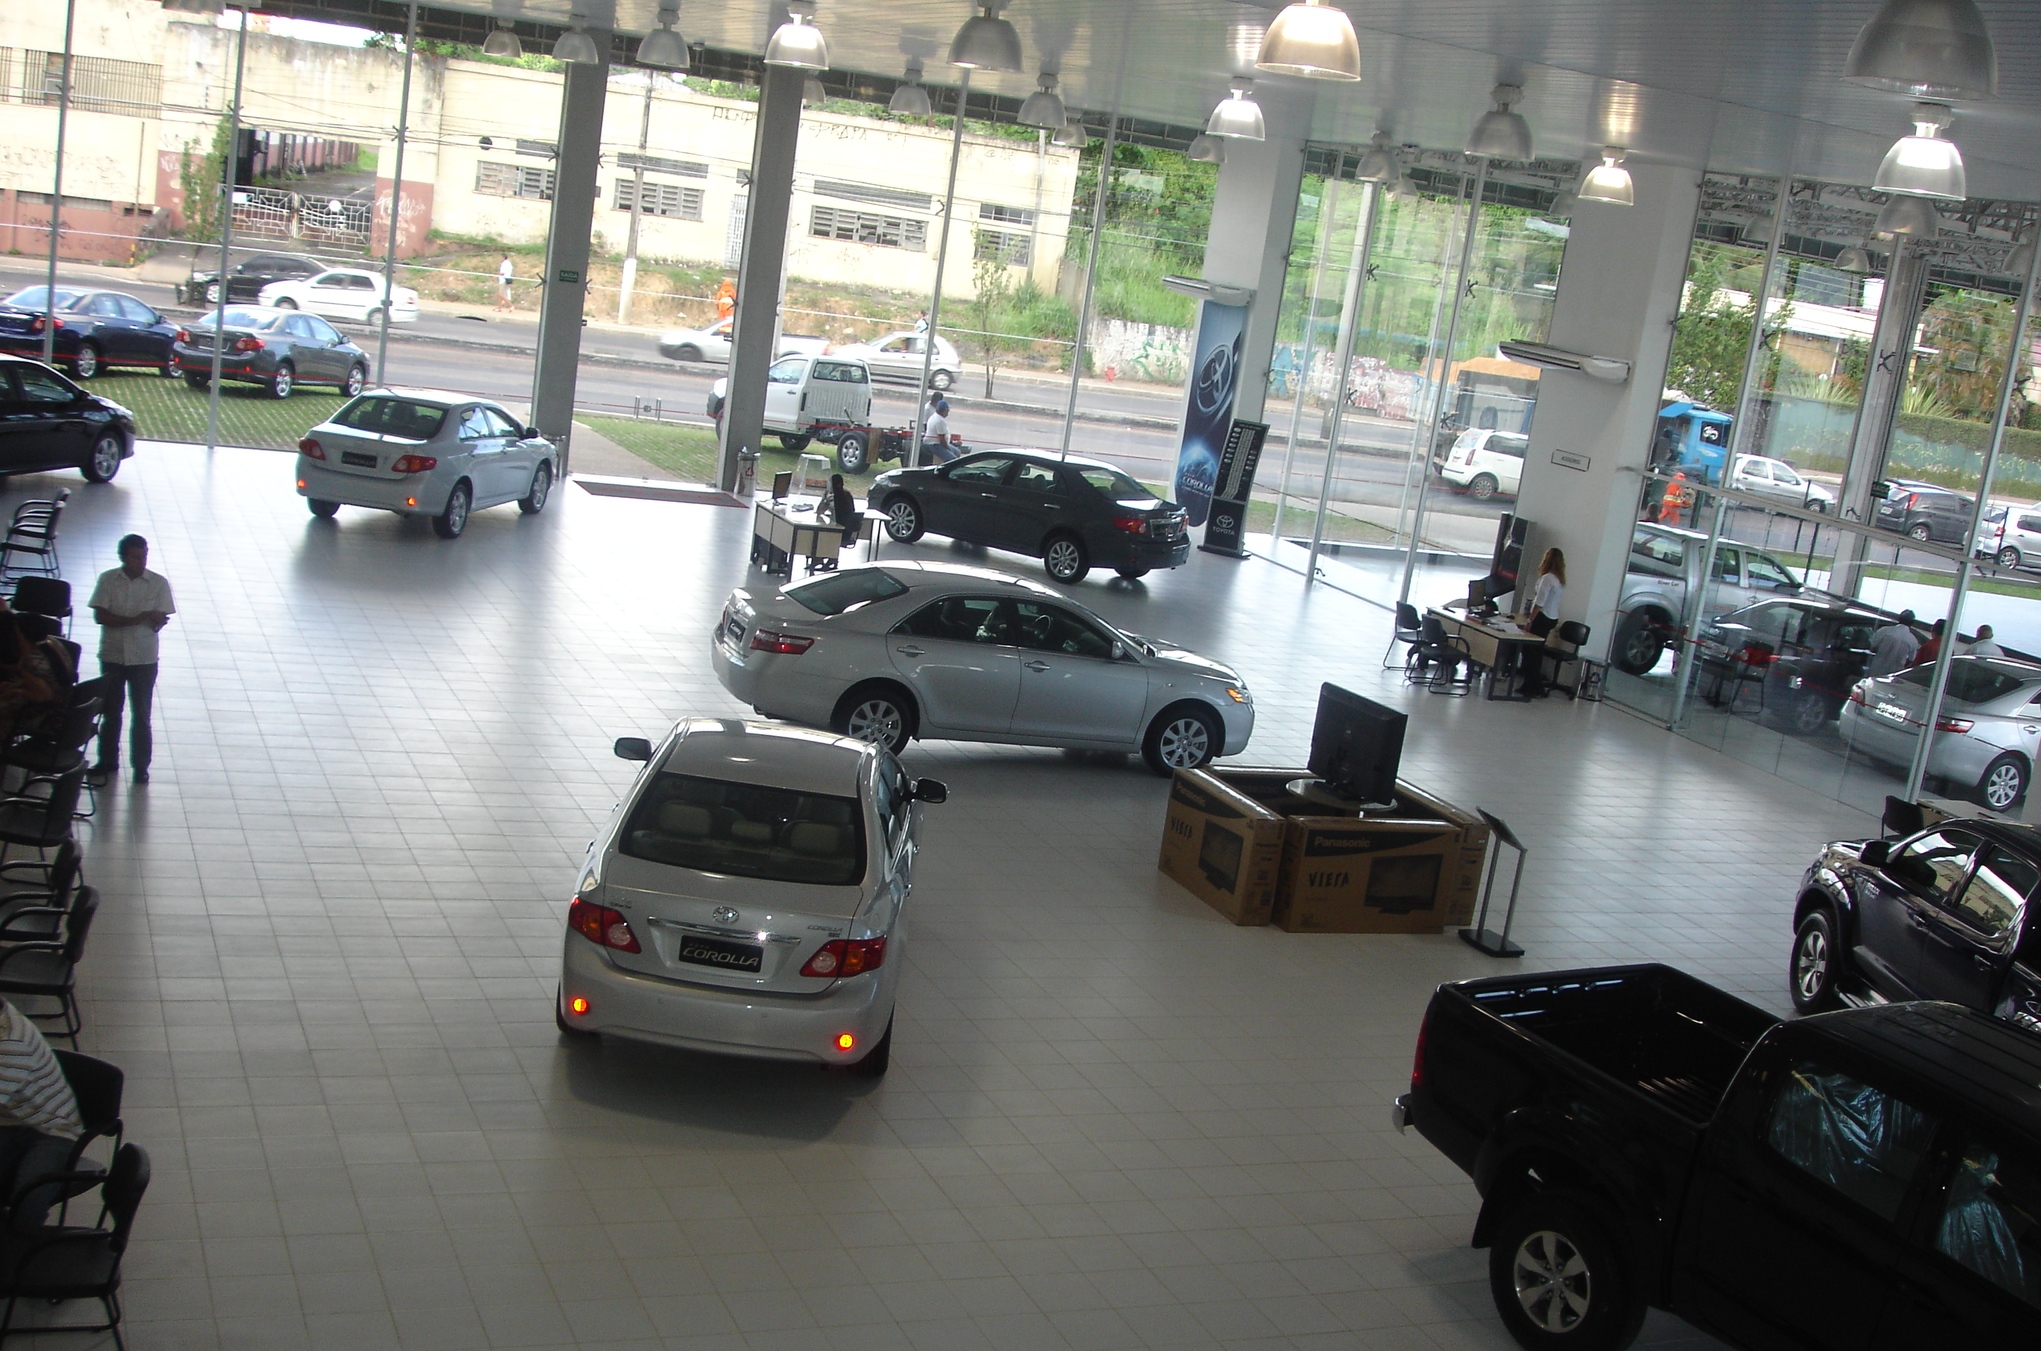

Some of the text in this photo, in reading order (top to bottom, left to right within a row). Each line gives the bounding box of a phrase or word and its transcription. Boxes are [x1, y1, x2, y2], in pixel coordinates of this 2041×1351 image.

[1182, 476, 1213, 491] COROLLA
[1213, 526, 1235, 536] TOYOTA
[1315, 837, 1371, 848] Panasonic
[683, 947, 759, 966] COROLLA
